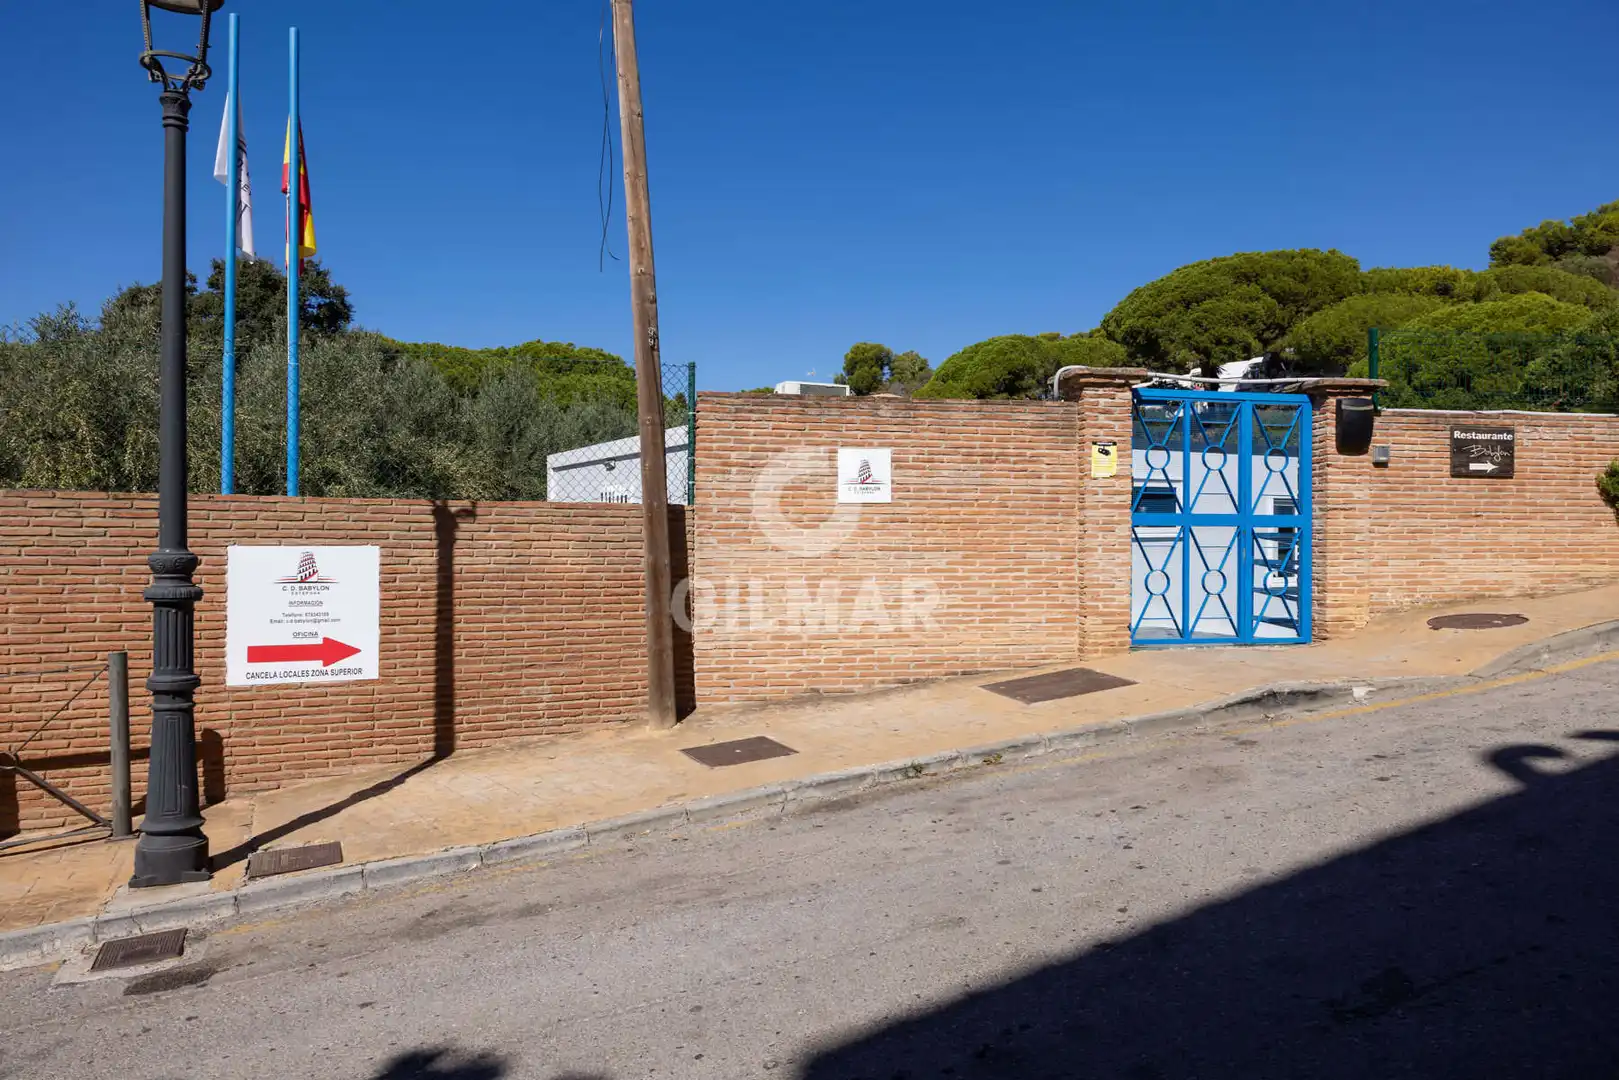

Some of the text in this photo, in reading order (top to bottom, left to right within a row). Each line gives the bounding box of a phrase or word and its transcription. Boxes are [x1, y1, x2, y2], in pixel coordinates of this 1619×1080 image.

[1453, 430, 1513, 440] Restaurante
[246, 667, 363, 680] CANCELA LOCALES ZONA SUPERIOR
